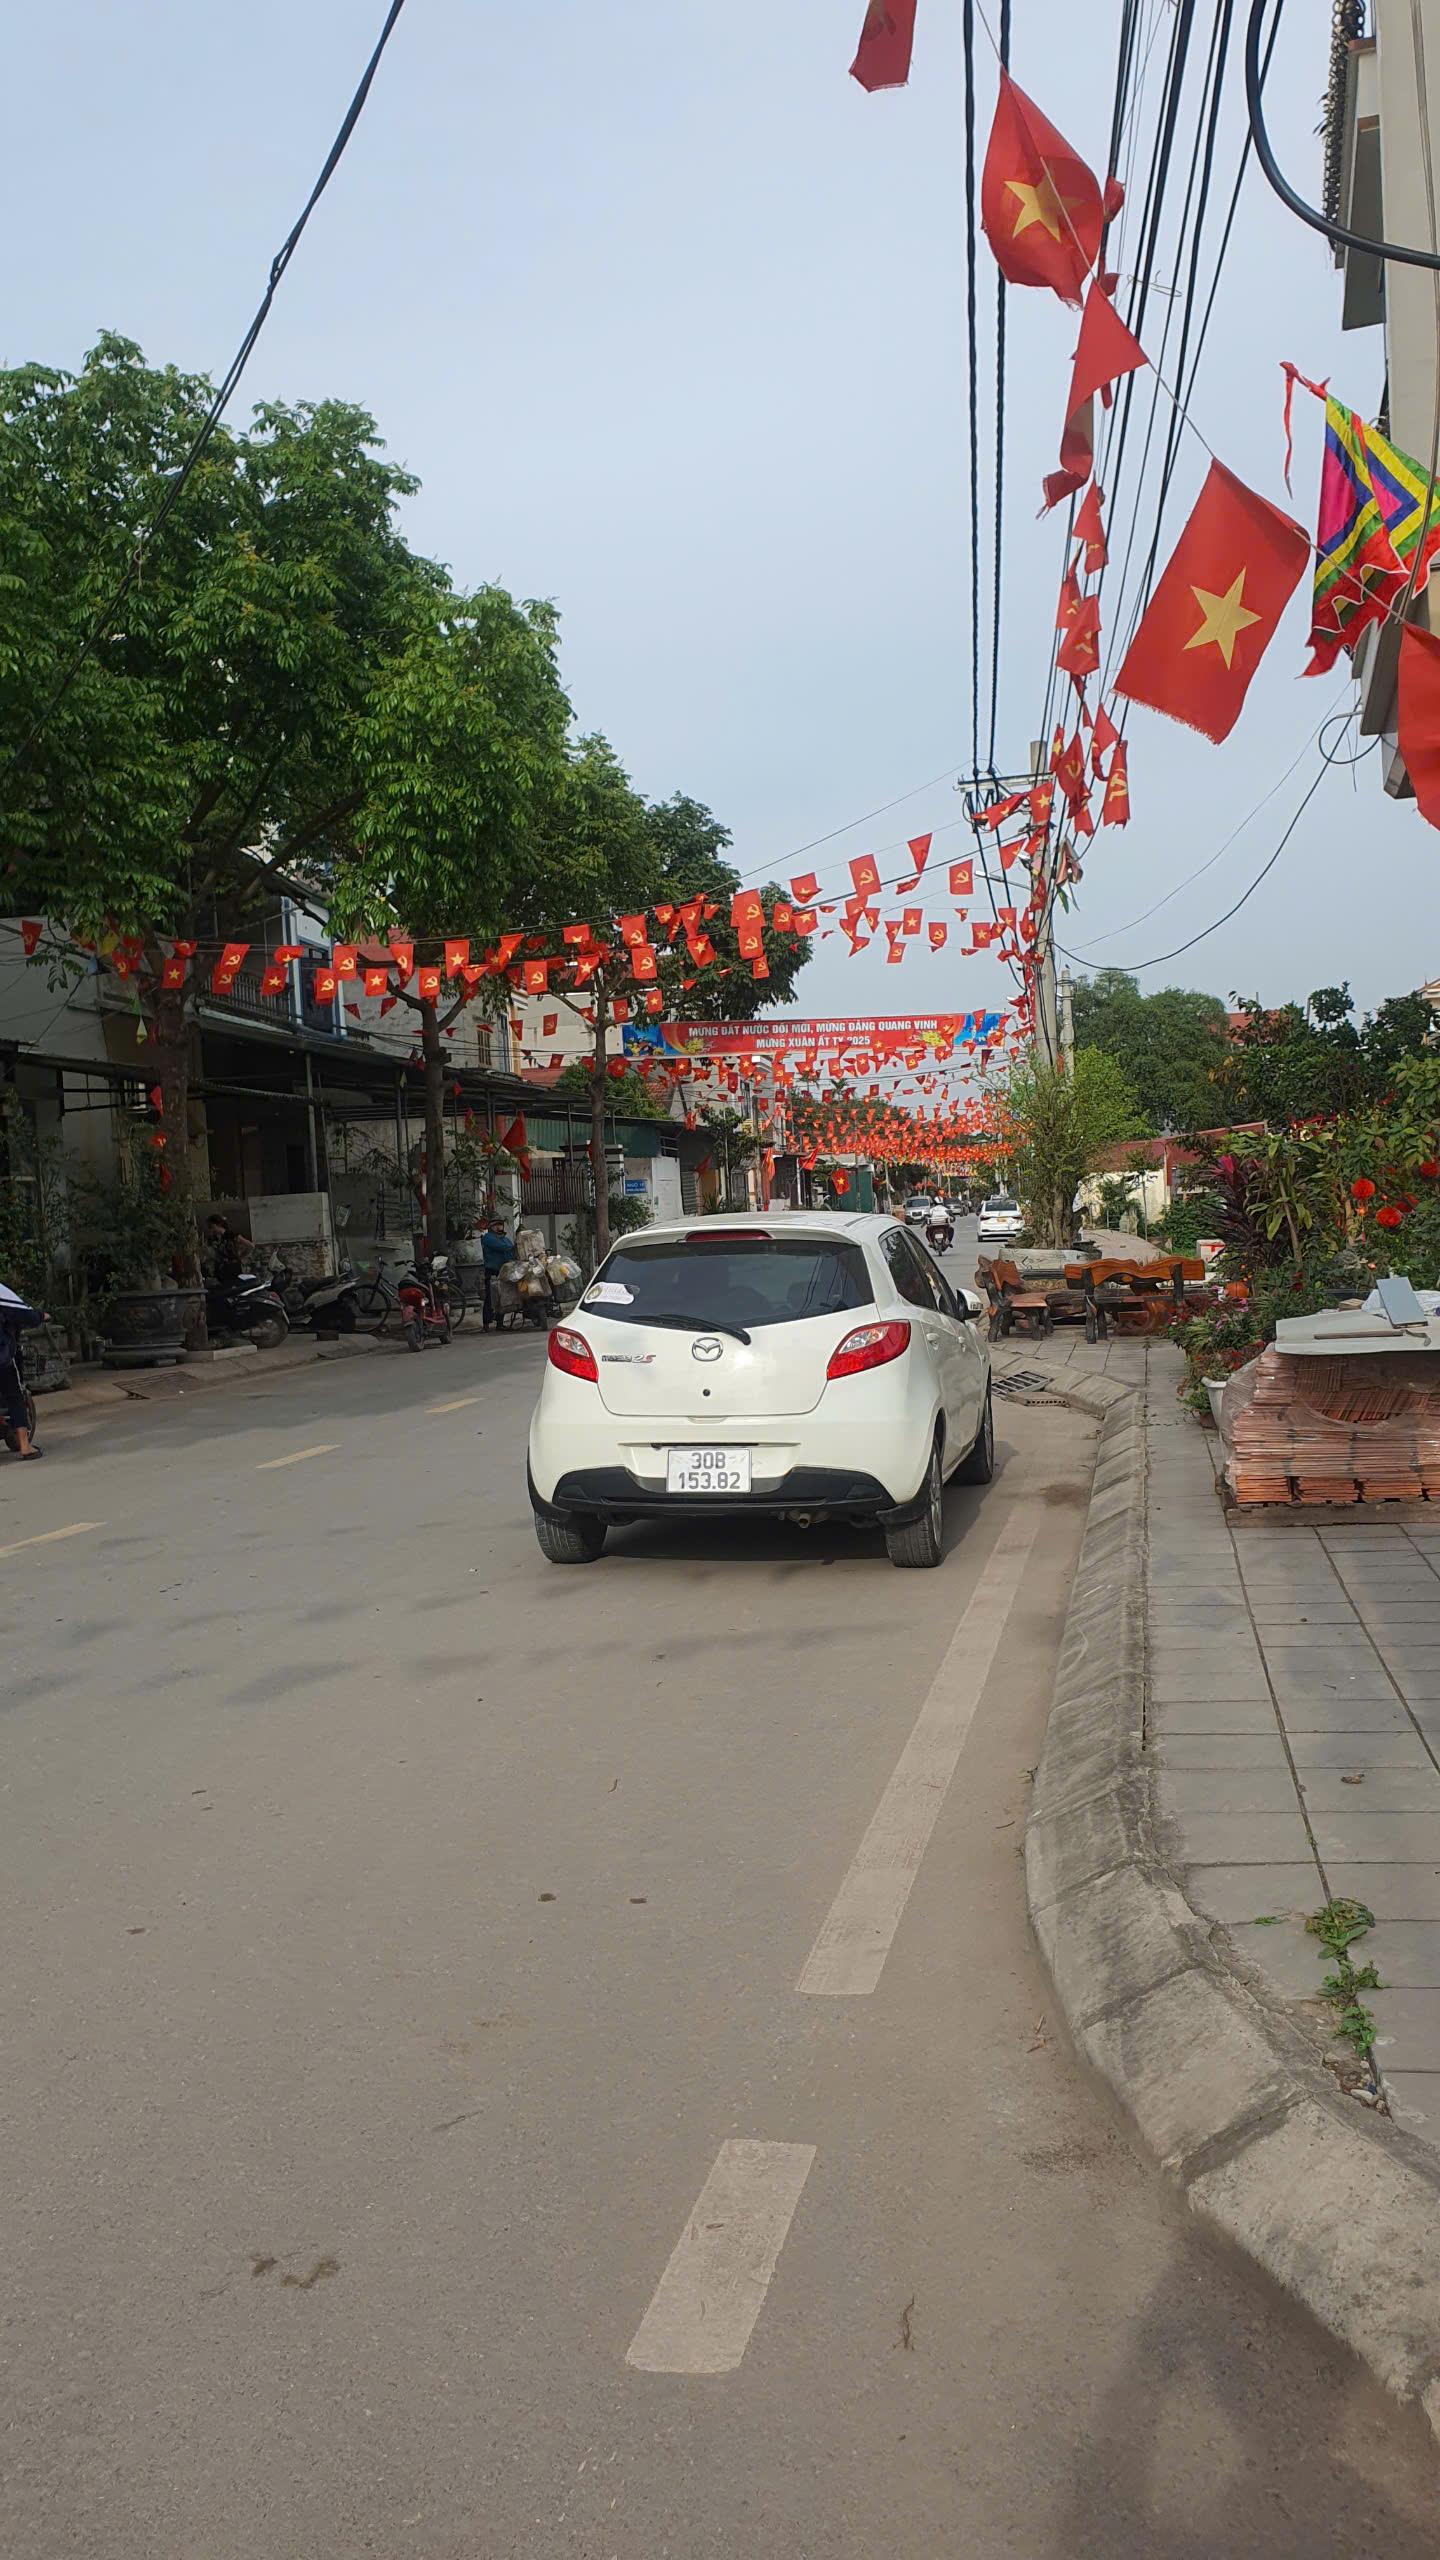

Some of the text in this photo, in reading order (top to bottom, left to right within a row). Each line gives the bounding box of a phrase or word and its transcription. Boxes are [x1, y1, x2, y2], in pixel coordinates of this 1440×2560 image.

[878, 1020, 911, 1031] QUANG
[914, 1019, 937, 1030] VINH
[788, 1035, 815, 1047] XUÂN
[691, 1452, 726, 1469] 30B
[679, 1472, 740, 1489] 153.82
